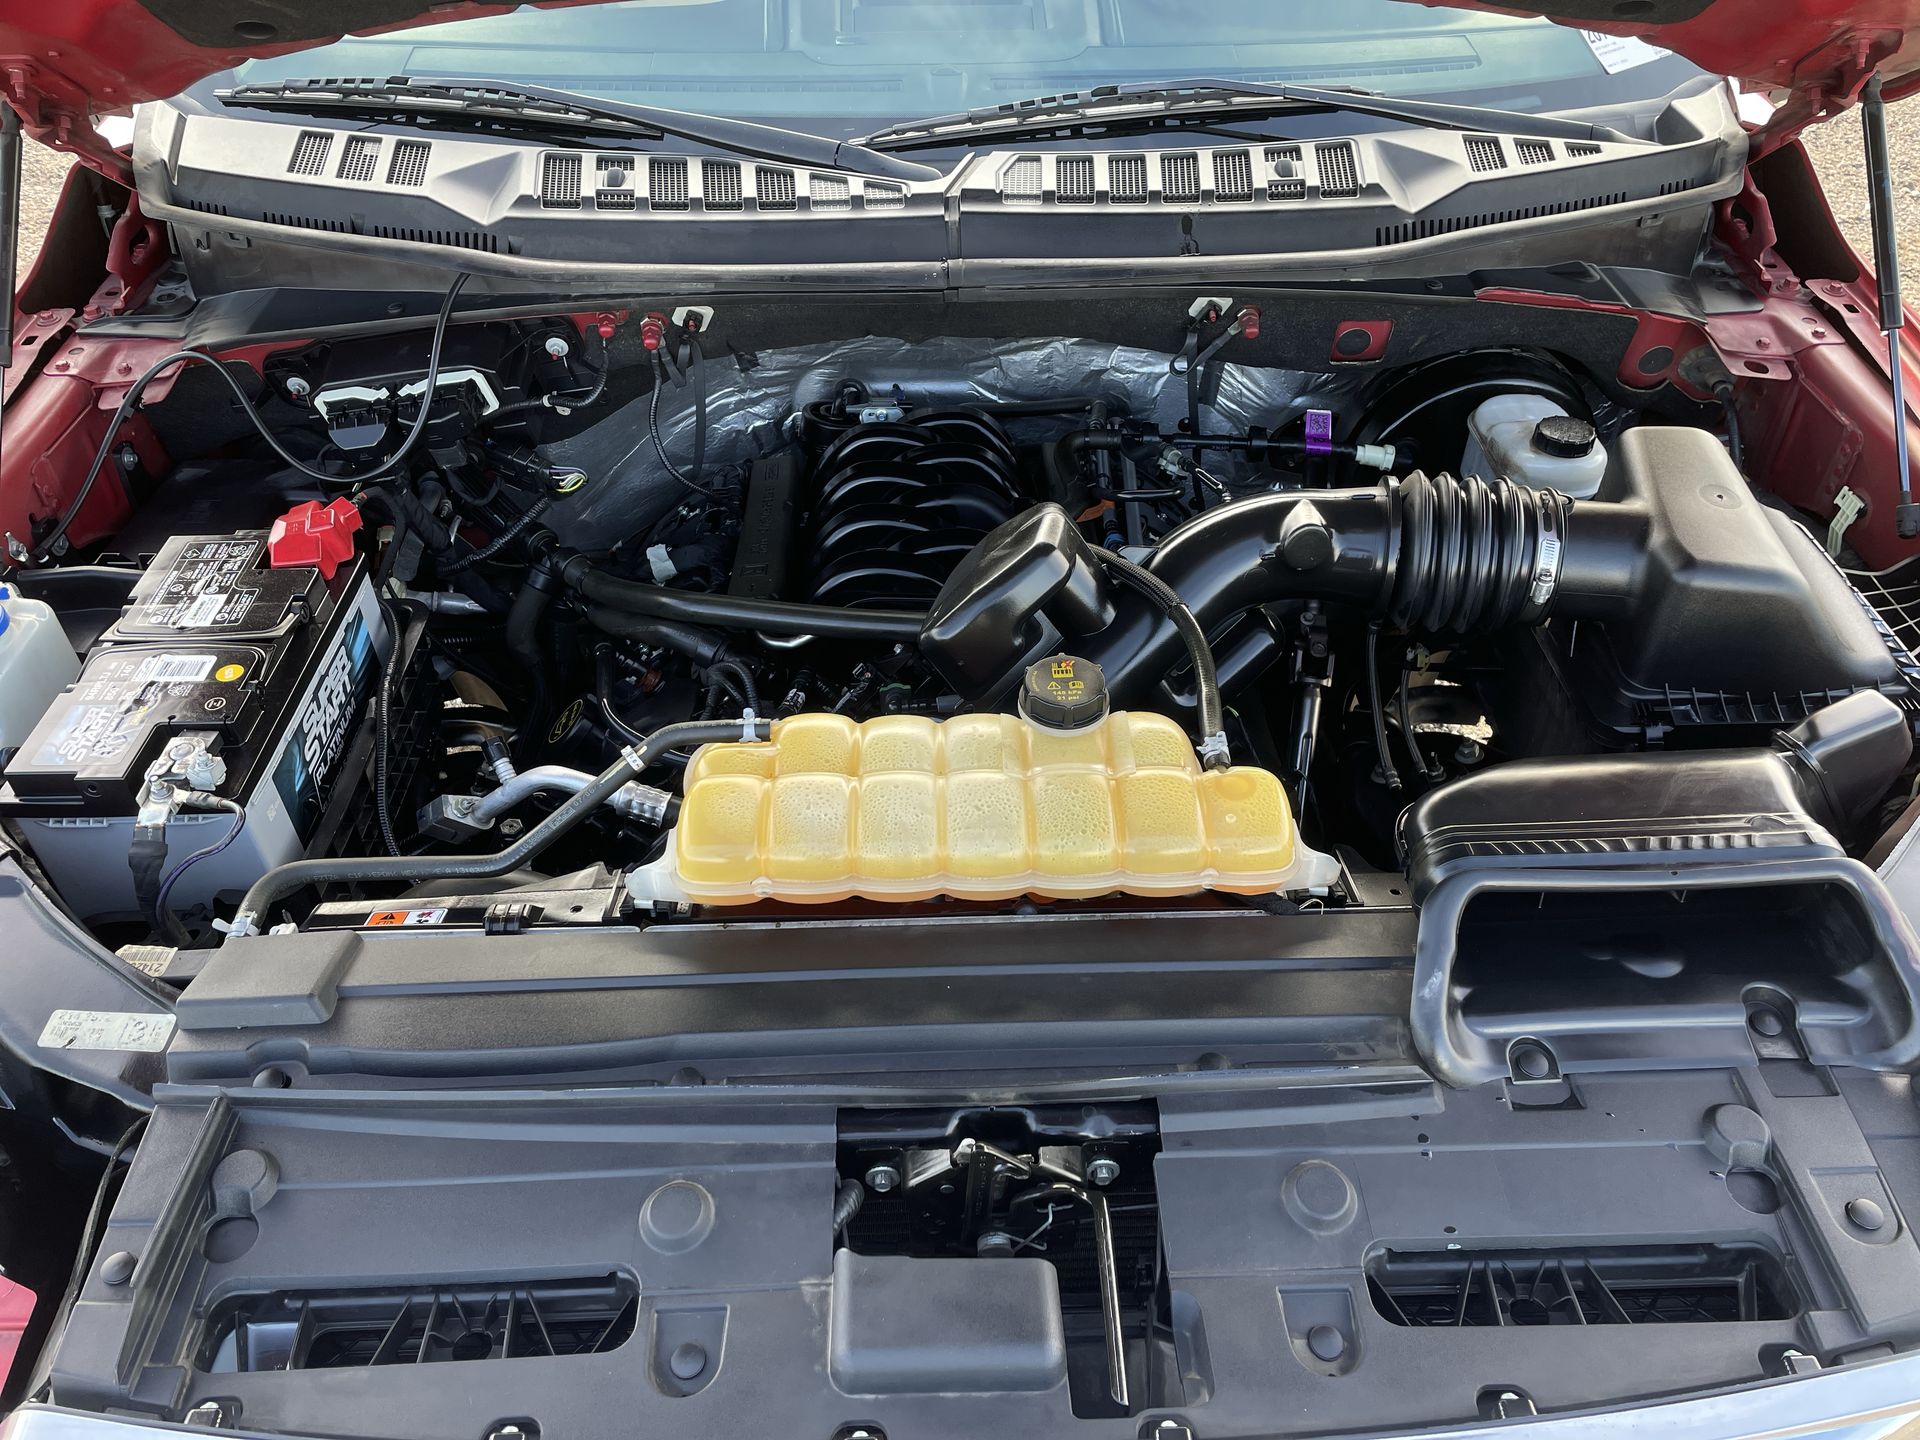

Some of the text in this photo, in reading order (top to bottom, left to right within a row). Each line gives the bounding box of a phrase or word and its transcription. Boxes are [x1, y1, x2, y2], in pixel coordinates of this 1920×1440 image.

[58, 706, 102, 755] SUPER
[302, 645, 350, 734] SUPER
[304, 662, 353, 776] START
[66, 706, 112, 763] START
[315, 697, 357, 786] PLATINUM
